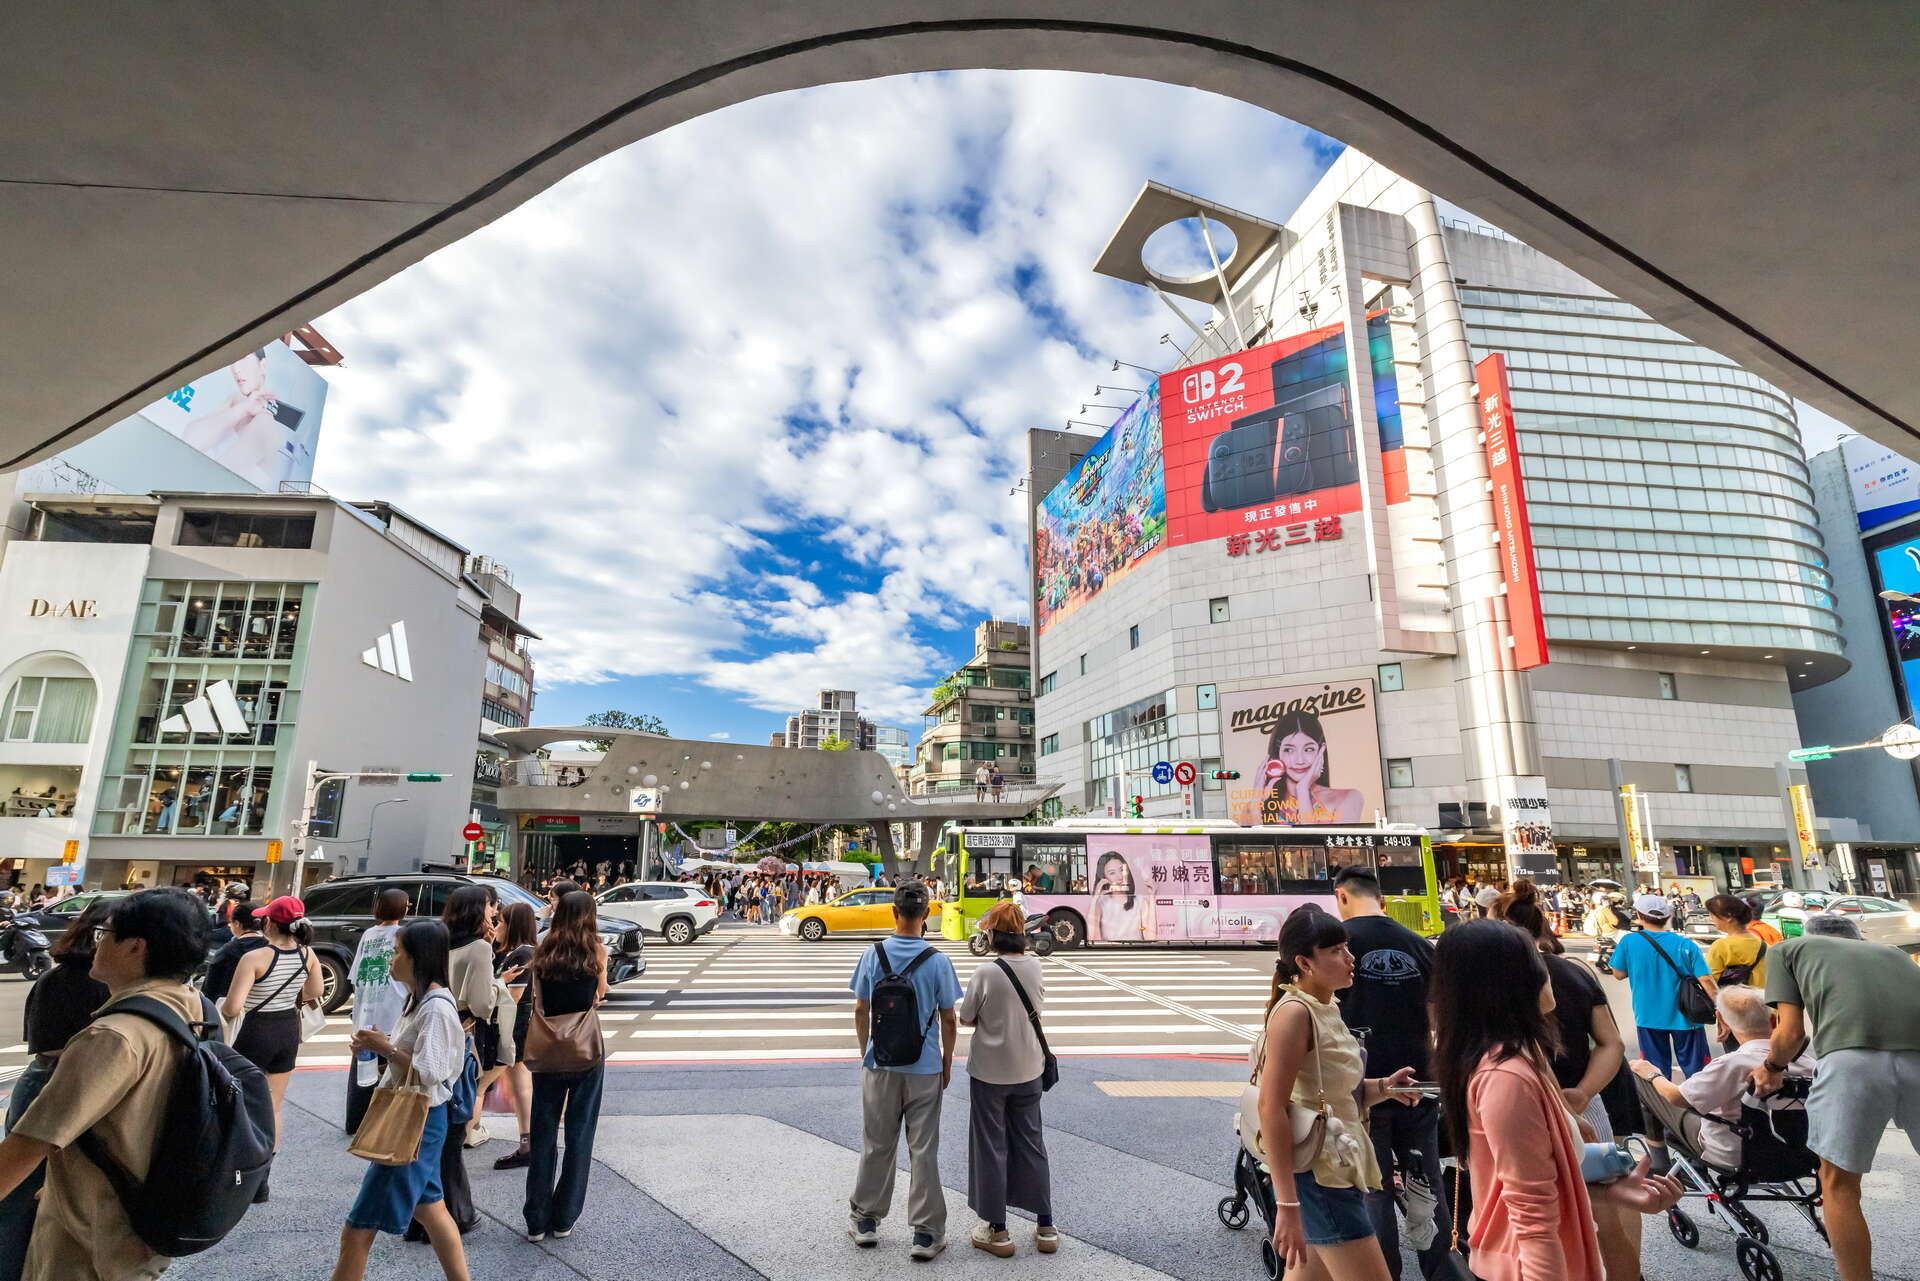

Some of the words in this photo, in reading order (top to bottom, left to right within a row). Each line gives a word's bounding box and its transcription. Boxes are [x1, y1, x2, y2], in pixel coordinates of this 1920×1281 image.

[1218, 362, 1245, 395] 2
[1187, 395, 1243, 414] NINTENDO
[1484, 392, 1507, 468] 新光三越
[1244, 499, 1318, 523] 現正發售中
[1226, 516, 1344, 558] 新光三越
[1231, 685, 1366, 735] magazine
[1268, 800, 1298, 812] OWN
[1326, 835, 1375, 848] 大都會客運
[1383, 836, 1412, 847] 549-U3
[1151, 865, 1210, 883] 粉嫩亮
[1211, 916, 1254, 927] Milcolla
